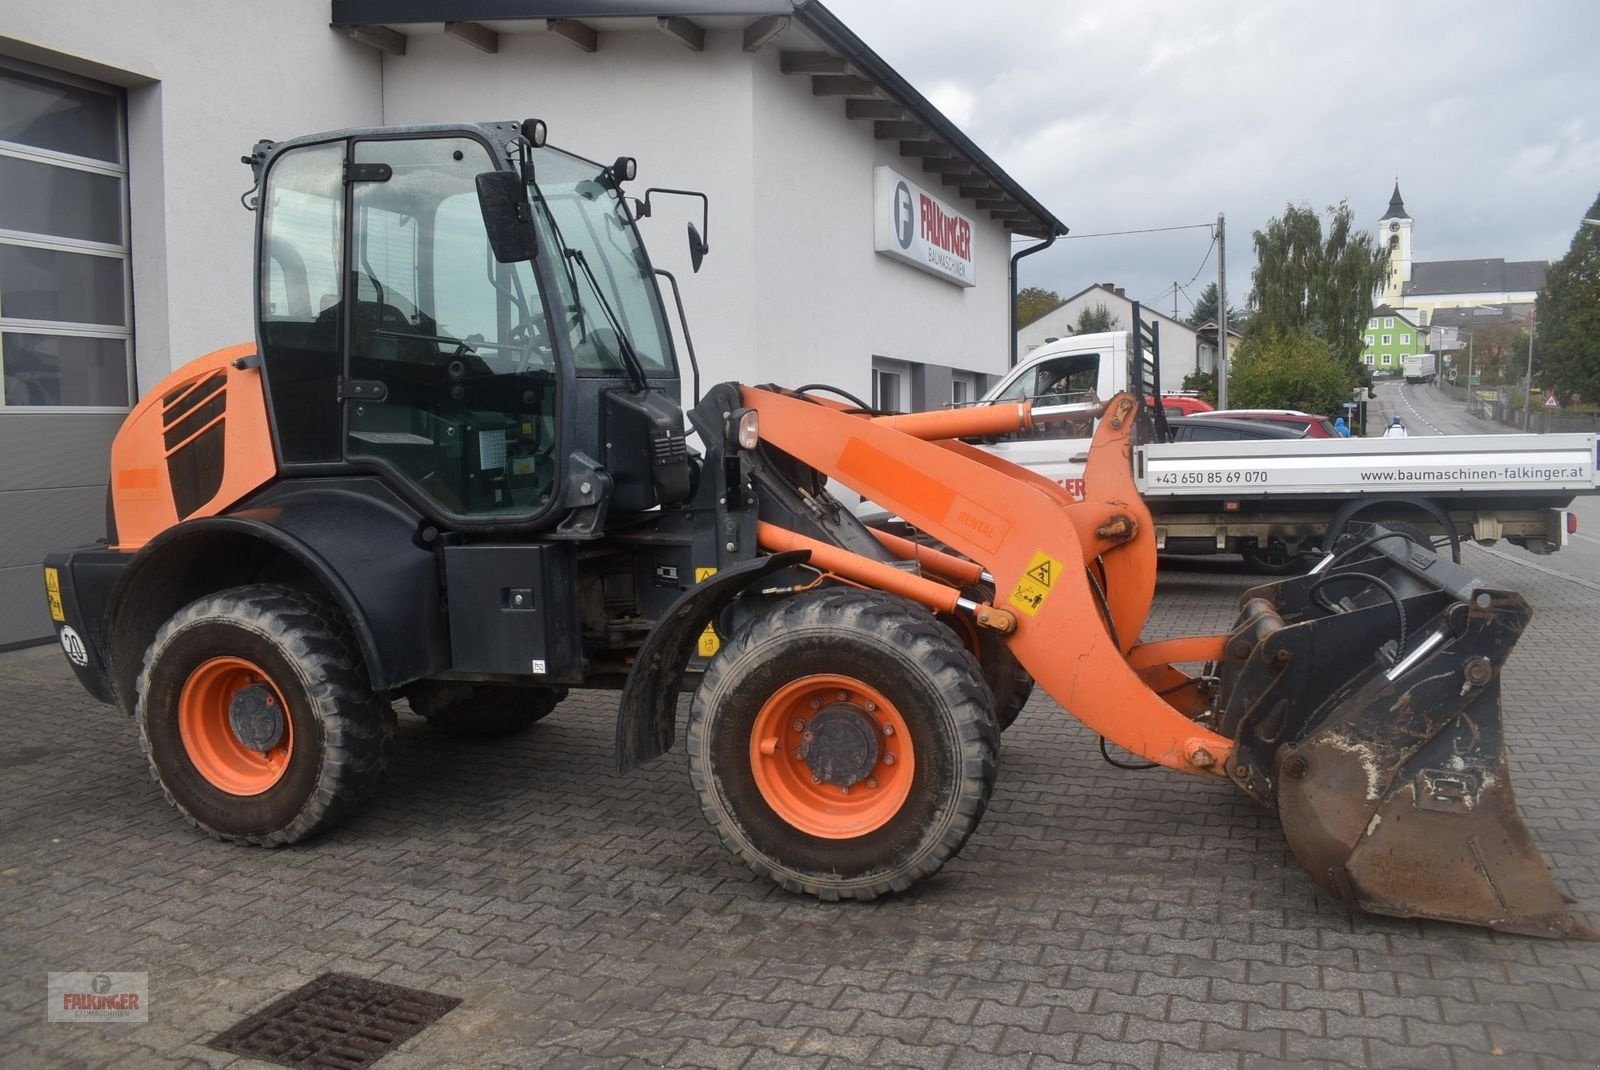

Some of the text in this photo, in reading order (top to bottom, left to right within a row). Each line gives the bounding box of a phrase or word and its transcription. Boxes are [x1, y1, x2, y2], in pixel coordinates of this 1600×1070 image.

[919, 193, 971, 262] FALKINGER
[1155, 471, 1268, 484] +43 650 85 69 070
[1360, 467, 1583, 481] www.baumaschinen-falkinger.at
[958, 511, 995, 540] RENTAL
[64, 634, 84, 659] 20
